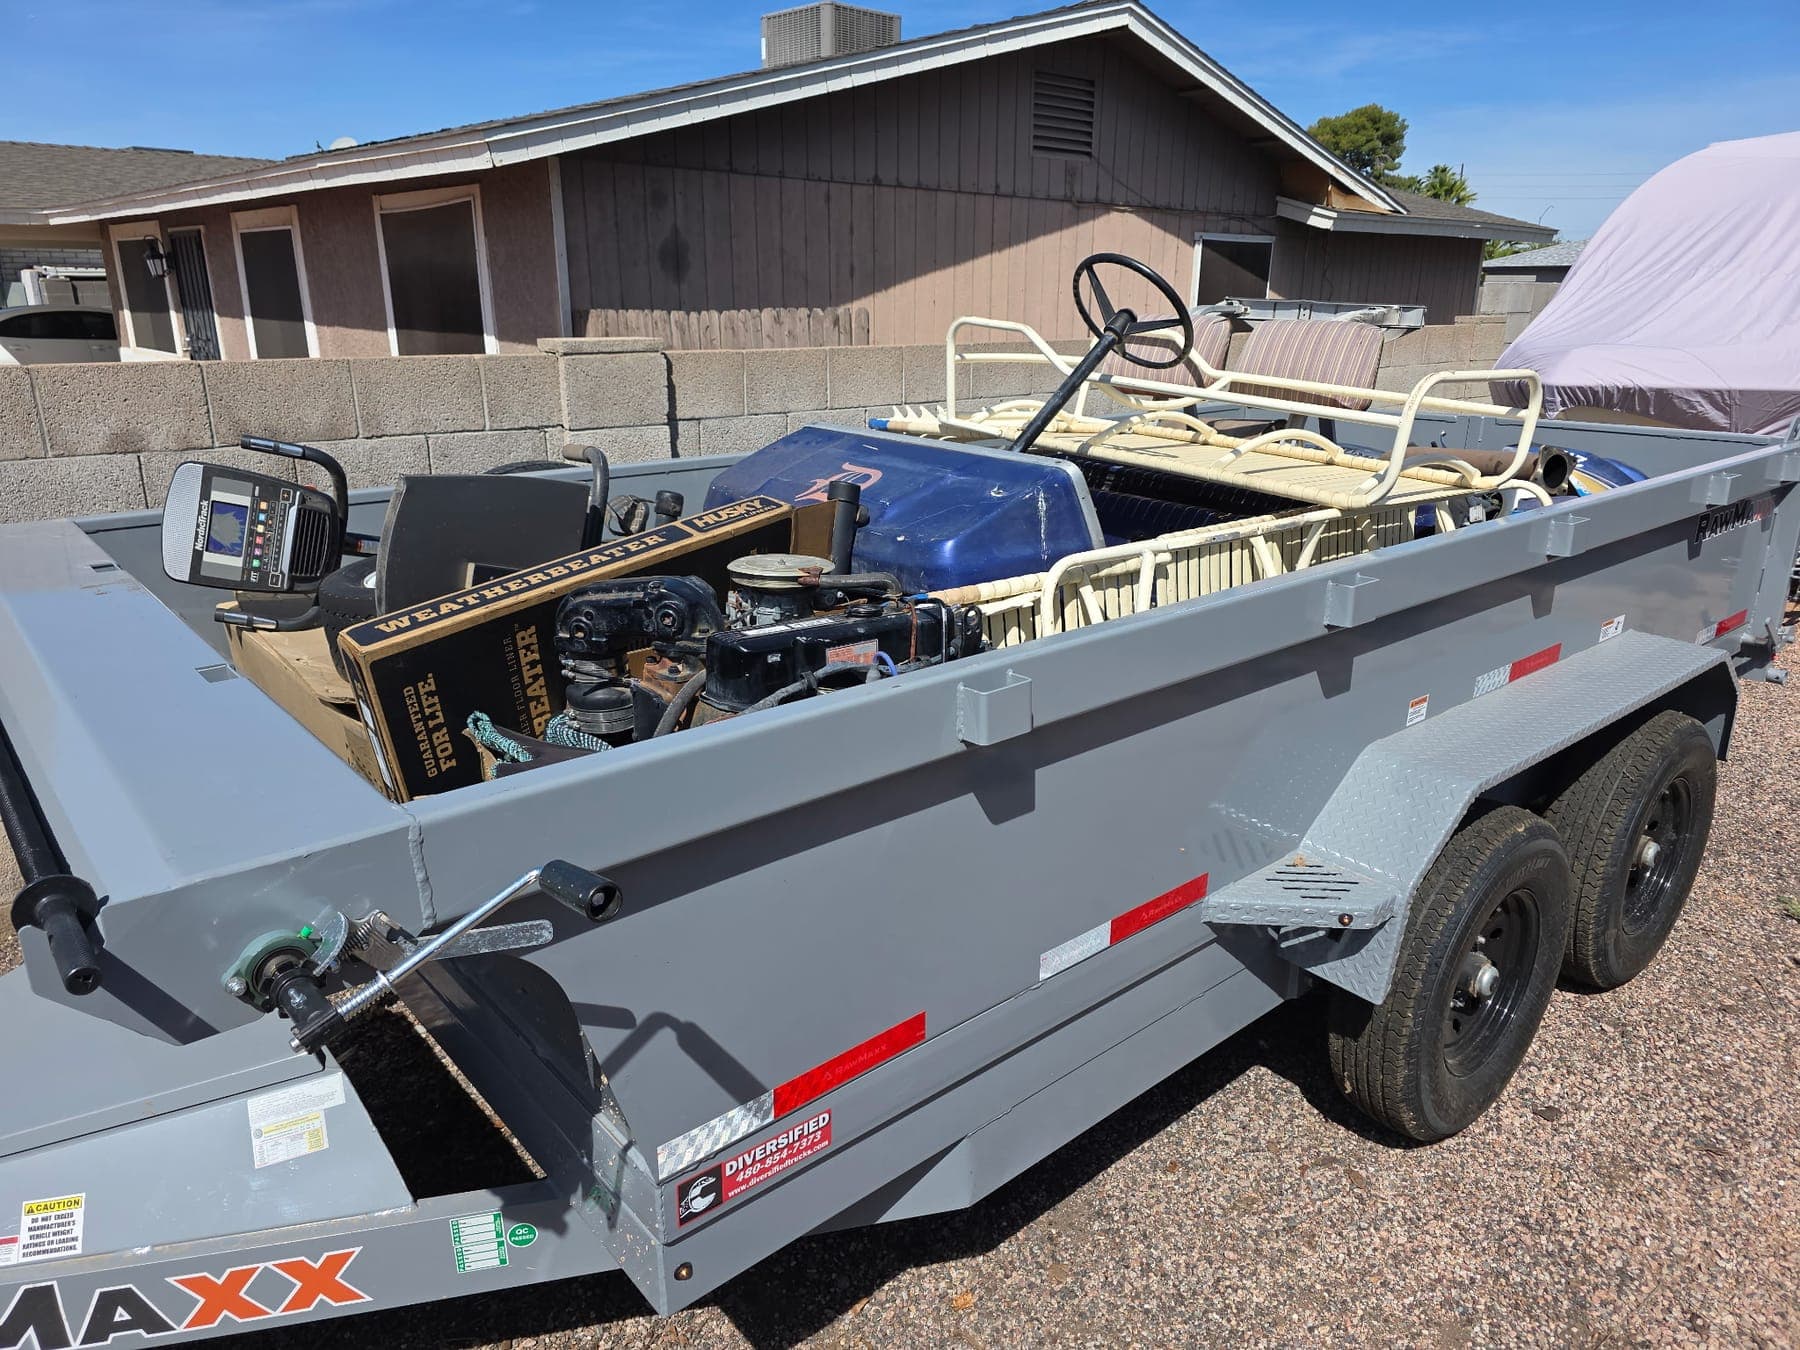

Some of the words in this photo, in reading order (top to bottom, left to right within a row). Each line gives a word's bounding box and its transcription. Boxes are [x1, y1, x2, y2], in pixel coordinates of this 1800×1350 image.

[194, 500, 209, 551] NordicTrack
[693, 500, 762, 528] HUSKY
[375, 534, 667, 633] WEATHERBEATER
[417, 672, 445, 729] LIFE.
[403, 686, 438, 778] GUARANTEED
[431, 727, 457, 772] FOR
[725, 1112, 831, 1177] DIVERSIFIED
[727, 1140, 829, 1198] www.diversifiedtrucks.com
[735, 1130, 823, 1182] 480-854-7373
[35, 1199, 80, 1212] CAUTION
[511, 1233, 535, 1242] PASSED
